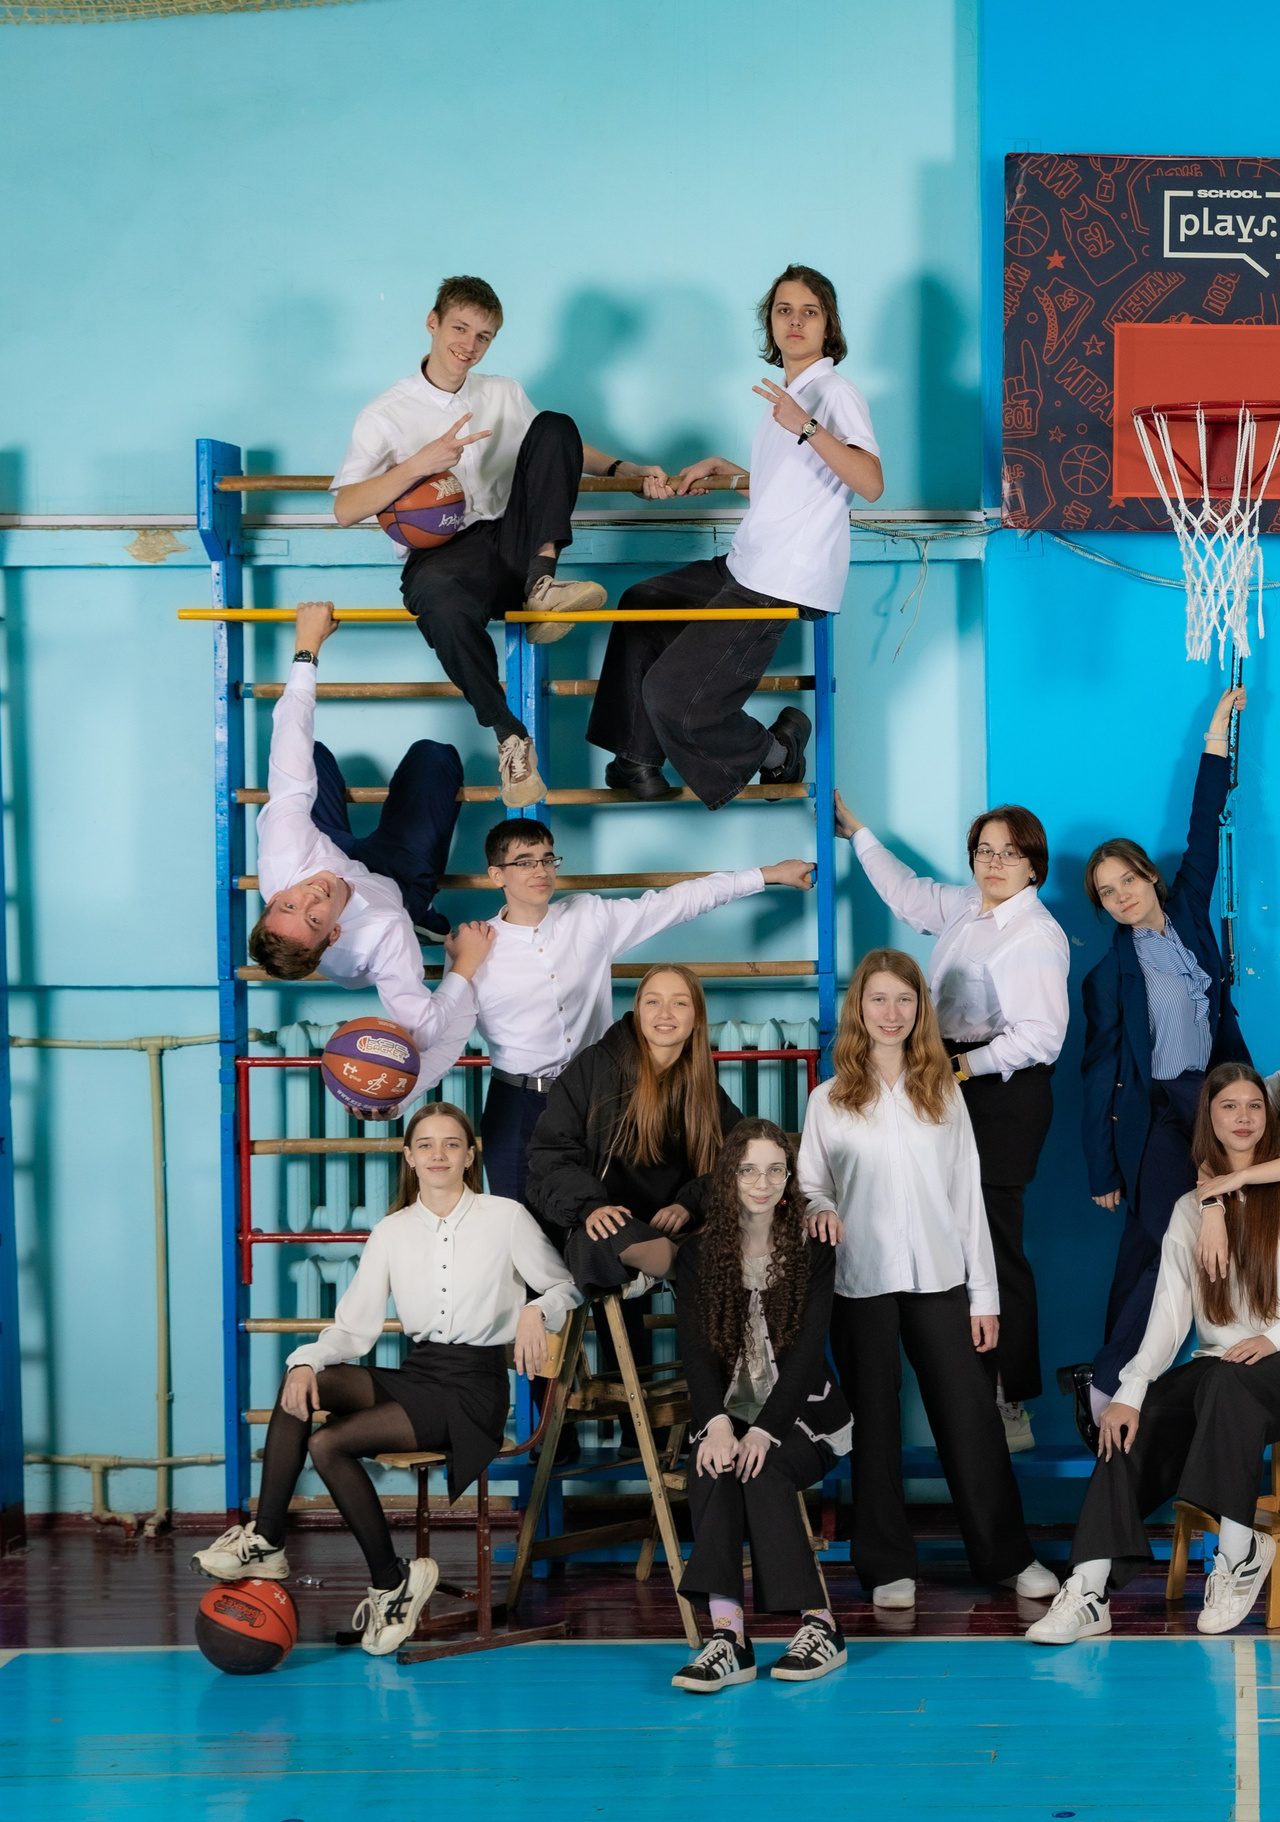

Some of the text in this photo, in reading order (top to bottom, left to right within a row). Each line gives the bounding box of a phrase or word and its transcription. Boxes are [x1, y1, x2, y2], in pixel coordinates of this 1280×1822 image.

[1197, 189, 1262, 199] SCHOOL
[1076, 221, 1115, 258] 52
[1054, 357, 1115, 428] ИГРА
